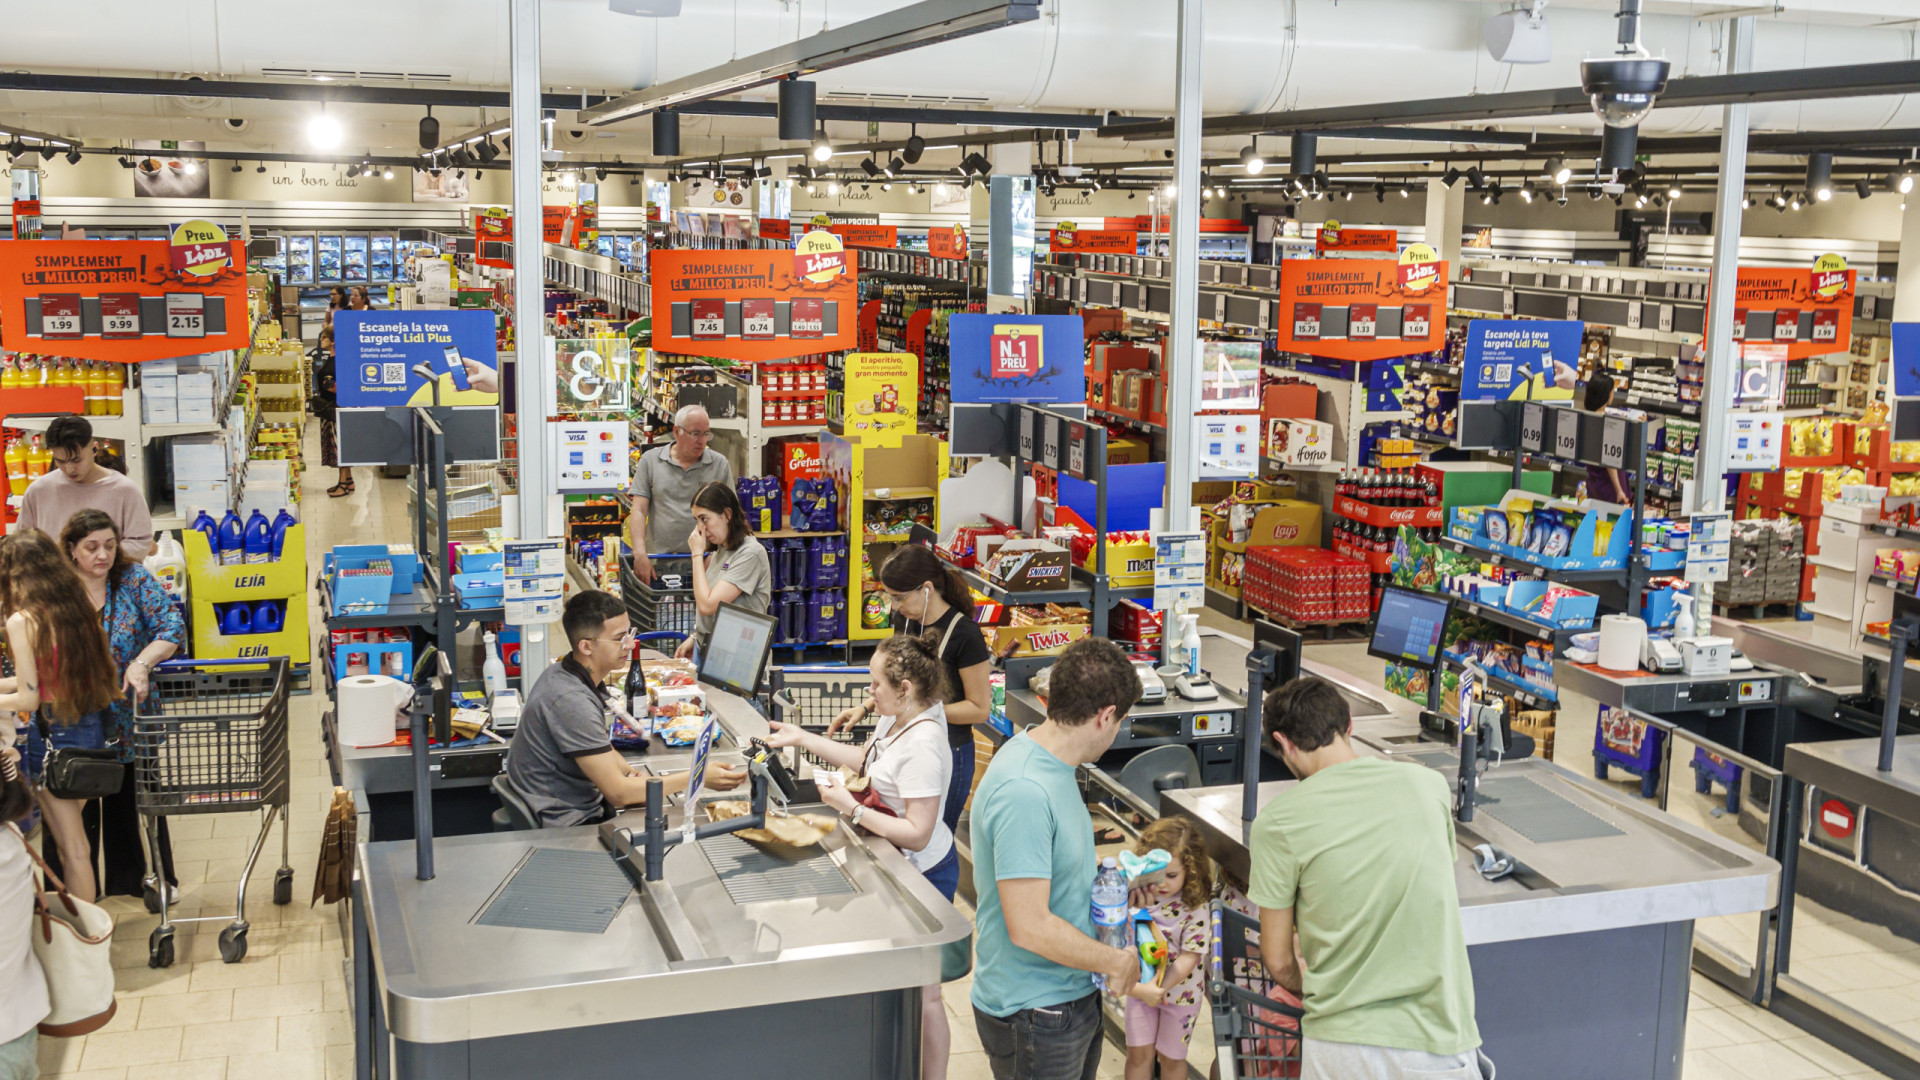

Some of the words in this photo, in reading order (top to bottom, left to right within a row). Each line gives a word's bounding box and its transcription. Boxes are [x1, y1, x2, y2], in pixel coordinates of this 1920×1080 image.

[272, 176, 293, 185] un
[301, 168, 328, 187] bon
[1050, 192, 1092, 211] gaudir
[185, 230, 215, 242] Preu
[808, 240, 832, 252] Preu
[36, 256, 122, 268] SIMPLEMENT
[1410, 252, 1429, 262] Preu
[682, 264, 754, 275] SIMPLEMENT
[1822, 260, 1839, 270] Preu
[25, 272, 40, 284] EL
[44, 270, 98, 284] MILLOR
[1306, 272, 1365, 281] SIMPLEMENT
[673, 280, 686, 290] EL
[690, 278, 732, 290] MILLOR
[1311, 284, 1346, 295] MILLOR
[1736, 279, 1782, 288] IMPLEMENT
[51, 320, 72, 330] 1.99
[110, 320, 132, 330] 9.99
[172, 316, 200, 329] 2.15
[359, 322, 409, 334] Escaneja
[412, 322, 422, 332] la
[424, 323, 449, 332] teva
[700, 323, 718, 332] 7.45
[750, 324, 768, 332] 0.74
[359, 334, 400, 346] targeta
[404, 333, 424, 343] Lidl
[428, 333, 452, 343] Plus
[1484, 330, 1520, 340] Escaneja
[1522, 330, 1530, 339] la
[1484, 340, 1512, 350] targeta
[1514, 340, 1530, 348] Lidl
[1532, 340, 1550, 348] Plus
[868, 356, 904, 364] aperitivo,
[1000, 358, 1026, 368] PREU
[1524, 428, 1540, 442] 0.99
[1020, 436, 1032, 450] 1.30
[1558, 436, 1574, 449] 1.09
[1045, 444, 1056, 458] 2.79
[1604, 444, 1622, 458] 1.09
[789, 457, 820, 470] Grefus
[1028, 566, 1062, 578] SNICKERS
[234, 574, 266, 588] LEJÍA
[238, 644, 268, 658] LEJÍA
